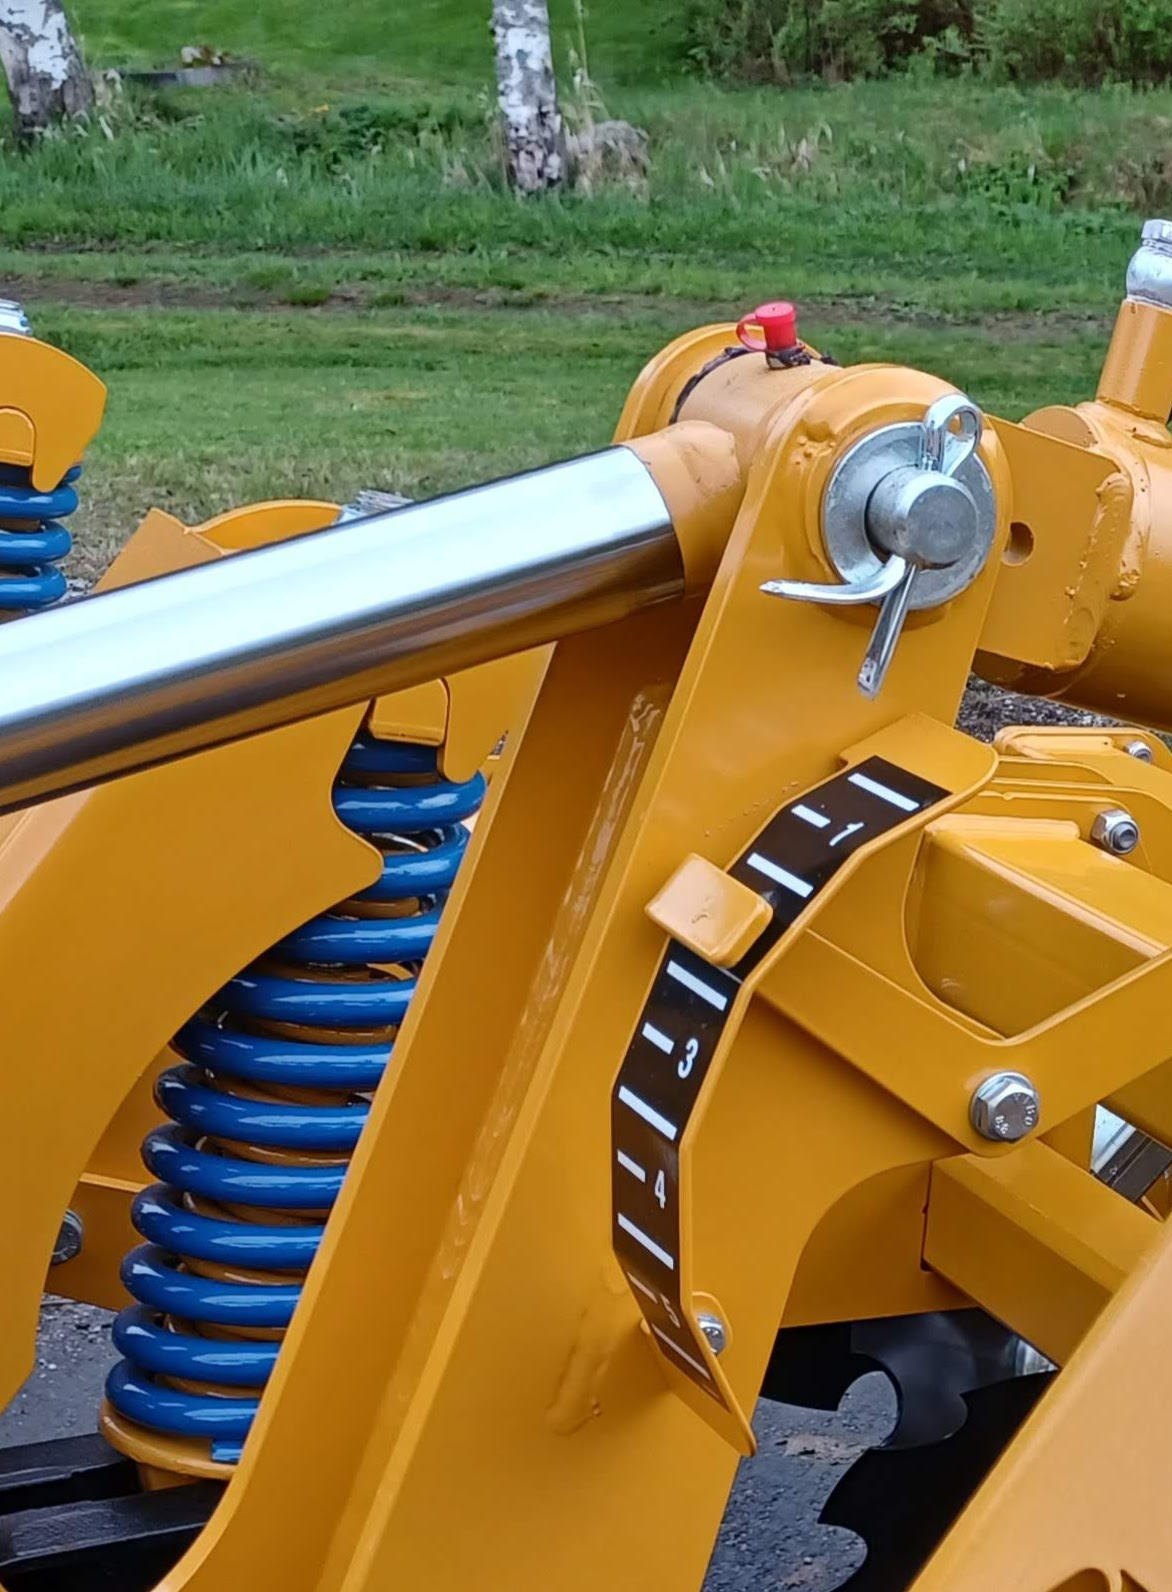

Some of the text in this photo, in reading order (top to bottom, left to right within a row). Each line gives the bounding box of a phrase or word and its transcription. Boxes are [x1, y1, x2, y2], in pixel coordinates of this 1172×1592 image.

[829, 821, 865, 847] 1
[677, 1037, 699, 1079] 3
[654, 1169, 666, 1209] 4
[660, 1293, 680, 1328] 5
